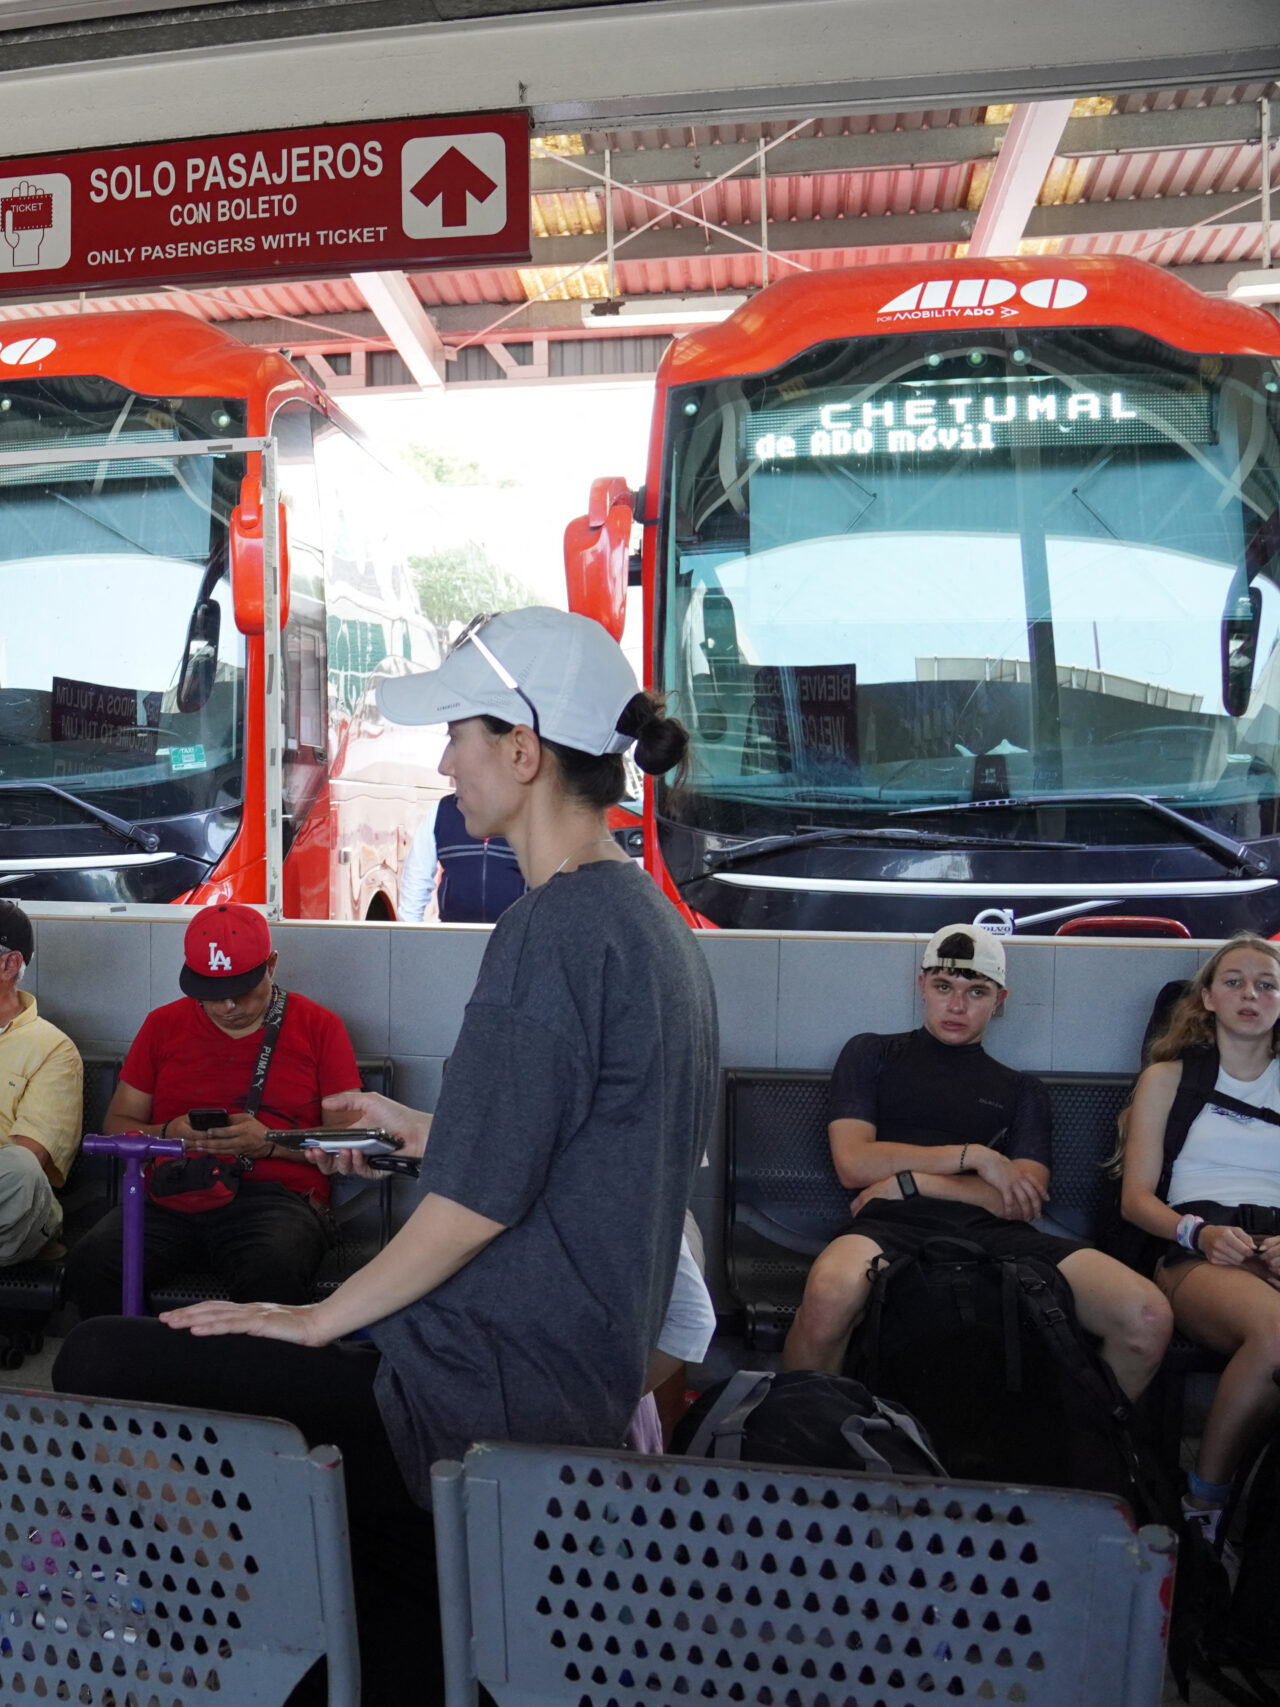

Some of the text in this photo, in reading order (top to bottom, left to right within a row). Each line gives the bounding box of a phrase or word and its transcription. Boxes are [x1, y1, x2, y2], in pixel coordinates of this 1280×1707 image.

[90, 140, 384, 203] SOLO PASAJEROS
[10, 203, 43, 213] TICKET
[170, 194, 297, 226] CON BOLETO
[87, 226, 388, 266] ONLY PASENGERS WITH TICKET
[877, 278, 1088, 314] ADO
[893, 308, 961, 321] MOBILITY
[963, 308, 995, 316] ADO
[820, 392, 1137, 429] CHETUMAL
[755, 422, 996, 460] de ADO móvil
[208, 942, 232, 971] LA
[274, 990, 287, 1016] PUMA
[255, 1046, 272, 1076] PUMA
